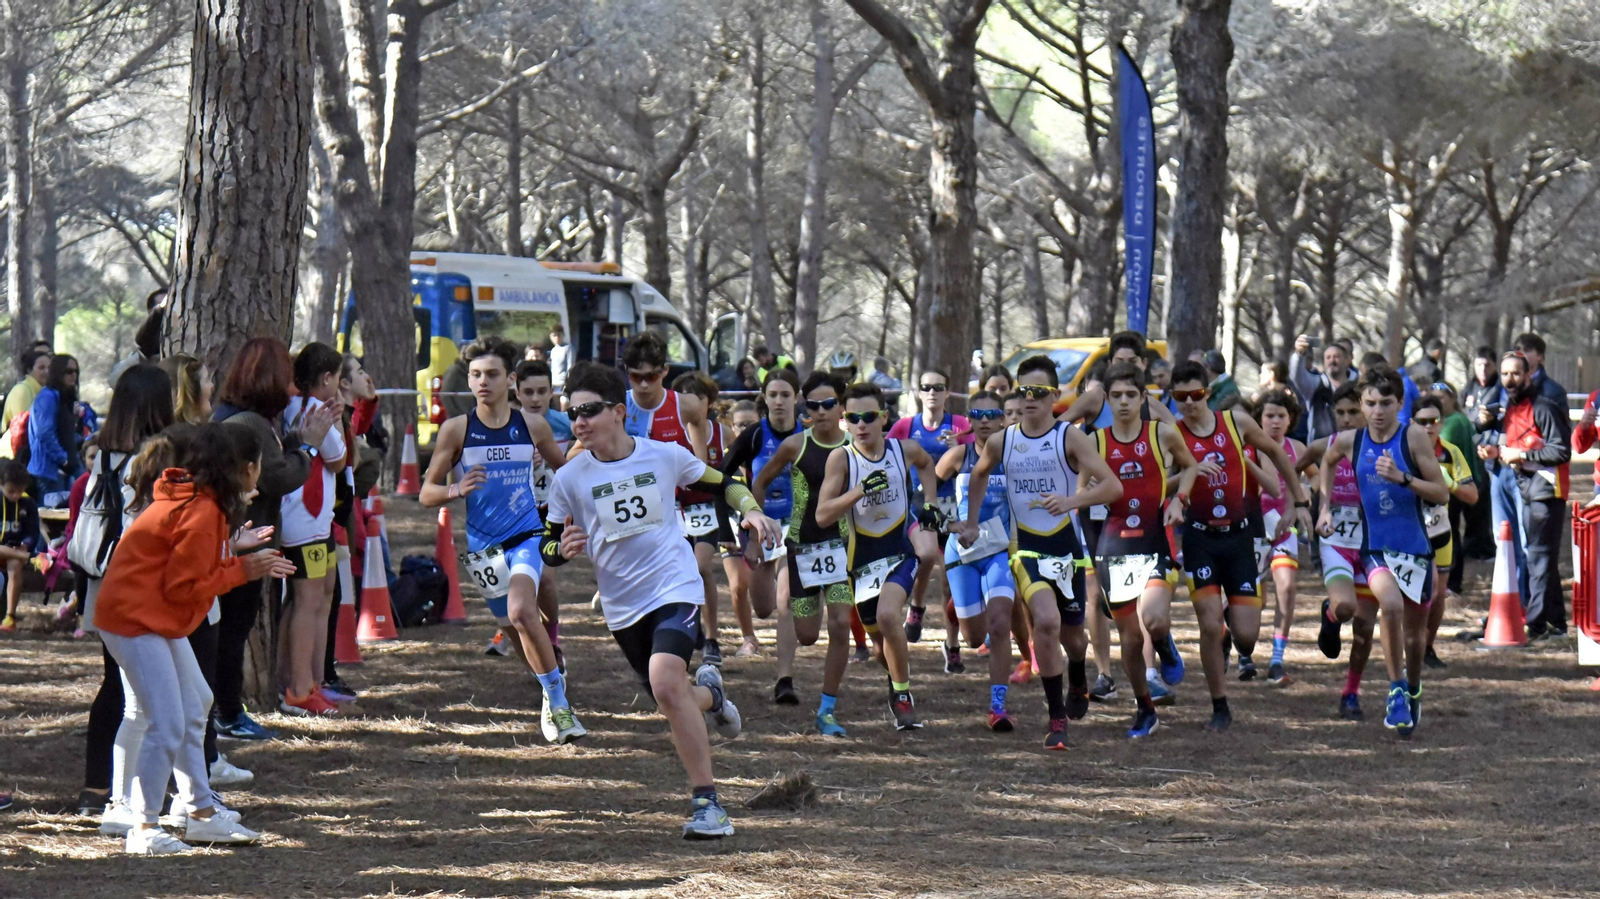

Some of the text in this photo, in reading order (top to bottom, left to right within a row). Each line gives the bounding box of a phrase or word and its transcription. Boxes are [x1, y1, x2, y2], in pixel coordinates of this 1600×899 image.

[499, 290, 561, 305] AMBULANCIA
[486, 447, 511, 462] CEDE
[534, 474, 547, 490] 4
[1013, 477, 1057, 494] ZARZUELA
[1207, 471, 1228, 487] JULIO
[861, 488, 899, 508] ZARZUELA
[614, 495, 647, 524] 53
[690, 514, 713, 528] 52
[1335, 521, 1360, 538] 47
[811, 556, 836, 575] 48
[473, 566, 499, 589] 38
